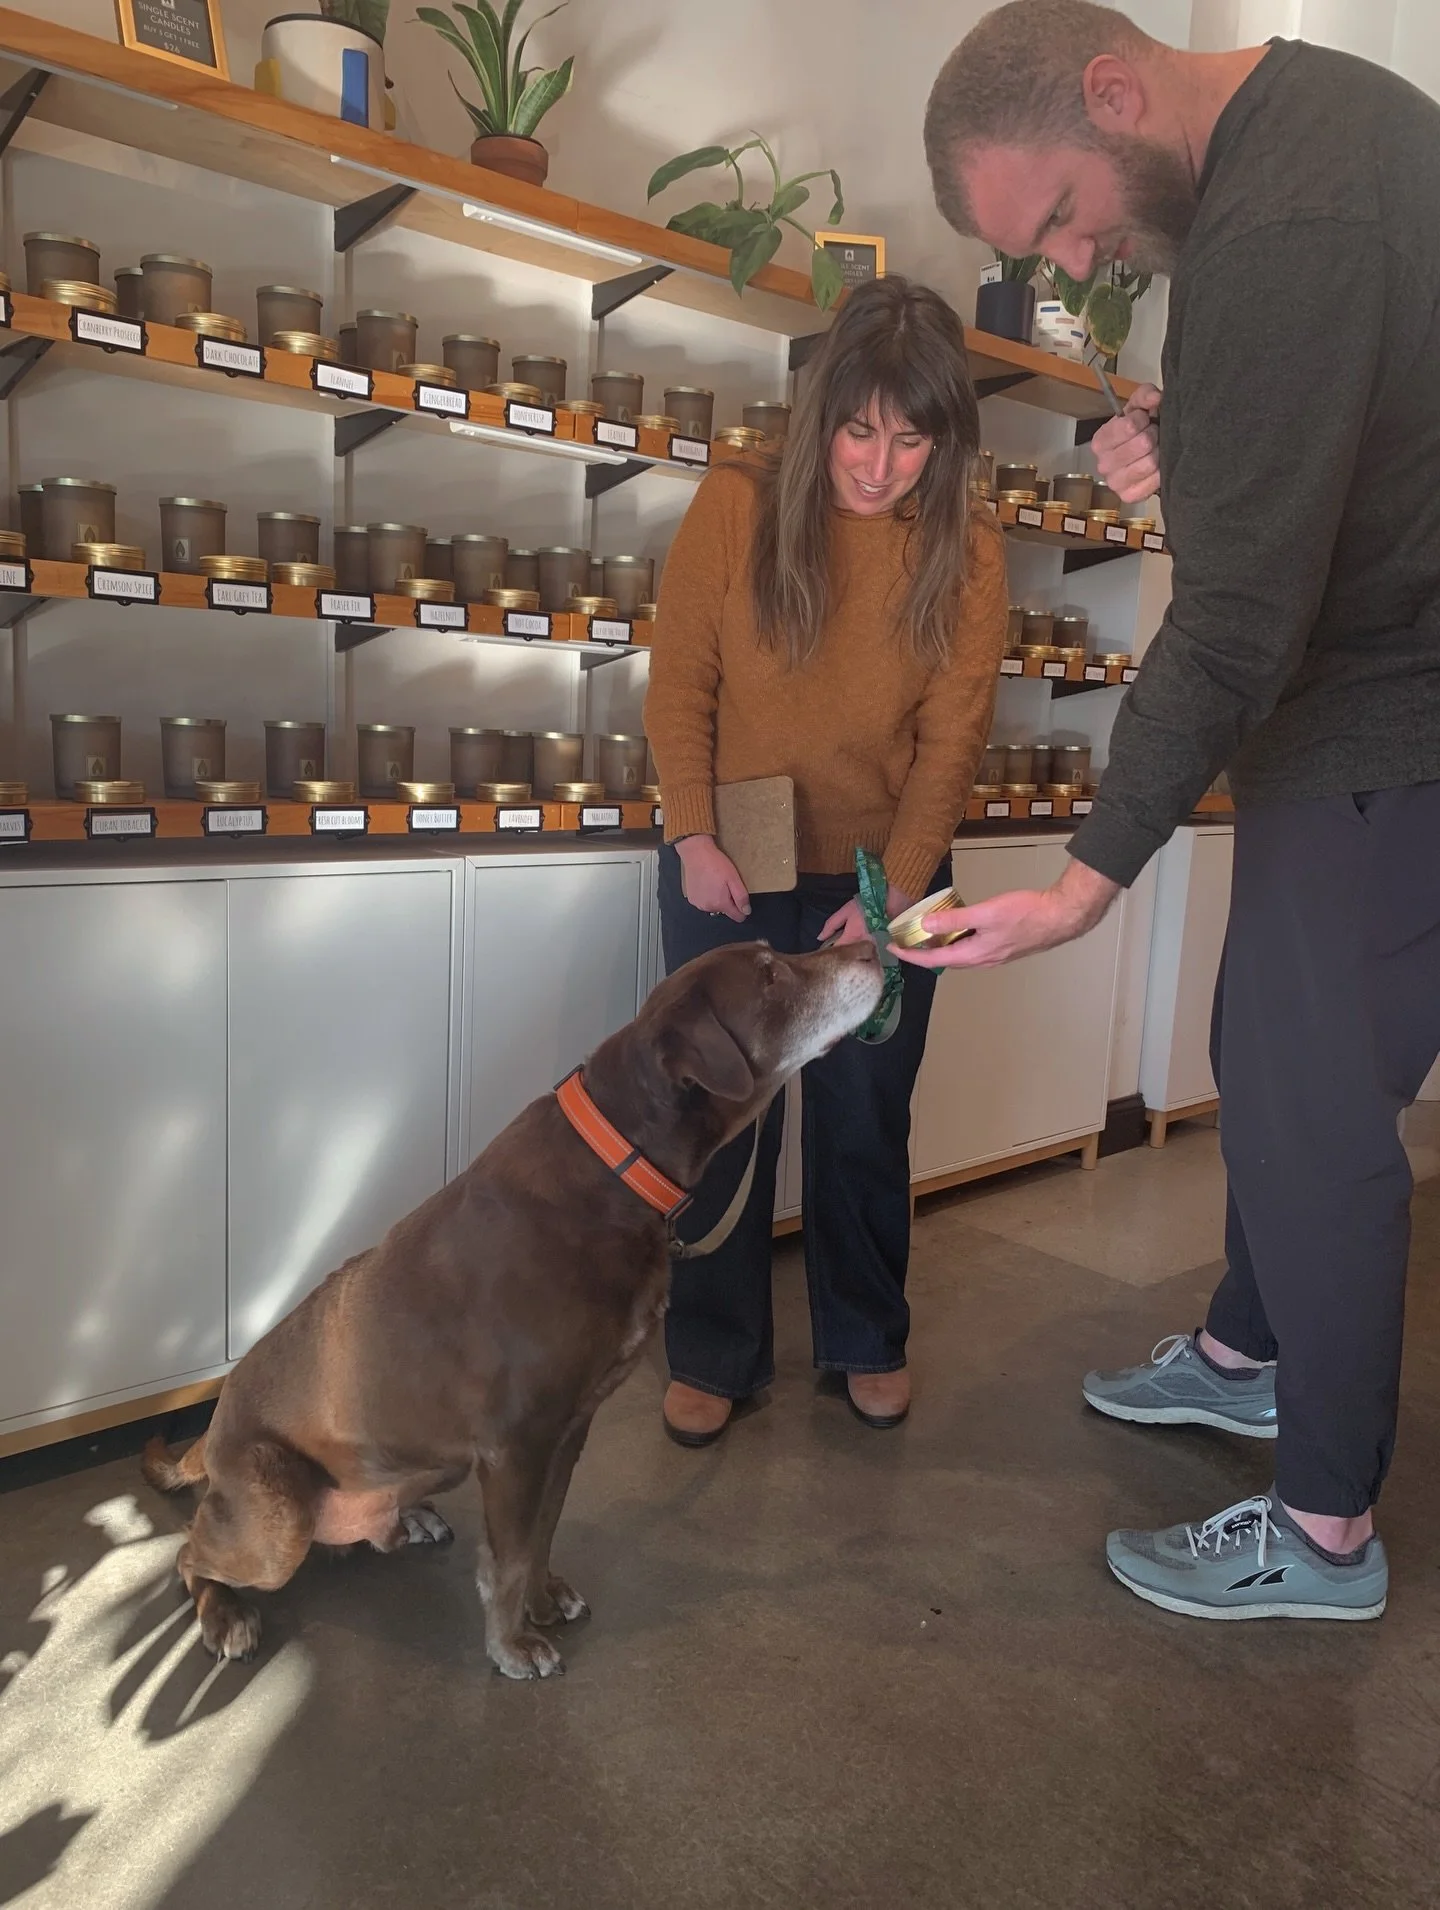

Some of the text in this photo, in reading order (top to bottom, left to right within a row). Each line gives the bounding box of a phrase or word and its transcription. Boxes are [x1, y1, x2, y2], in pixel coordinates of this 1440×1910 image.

[138, 2, 200, 29] SINGLE SCENT
[143, 24, 157, 34] BUY
[164, 31, 177, 41] GET
[150, 15, 191, 36] CANDLES
[78, 319, 141, 343] CRANBERRY PROSECCO
[205, 347, 259, 368] DARK CHOCOLATE
[423, 391, 463, 409] GINGERBREAD
[513, 409, 545, 424] HONEYCRISP
[97, 577, 153, 596] CRIMSON SPICE
[217, 588, 264, 604] EARL GREY TEA
[330, 598, 350, 611] FRASER
[430, 611, 456, 622] HAZELNUT
[95, 817, 149, 833] CUBAN TOBACCO
[216, 813, 254, 827] EUCALYPTUS
[331, 815, 341, 825] CUT
[508, 814, 533, 825] LAVENDER
